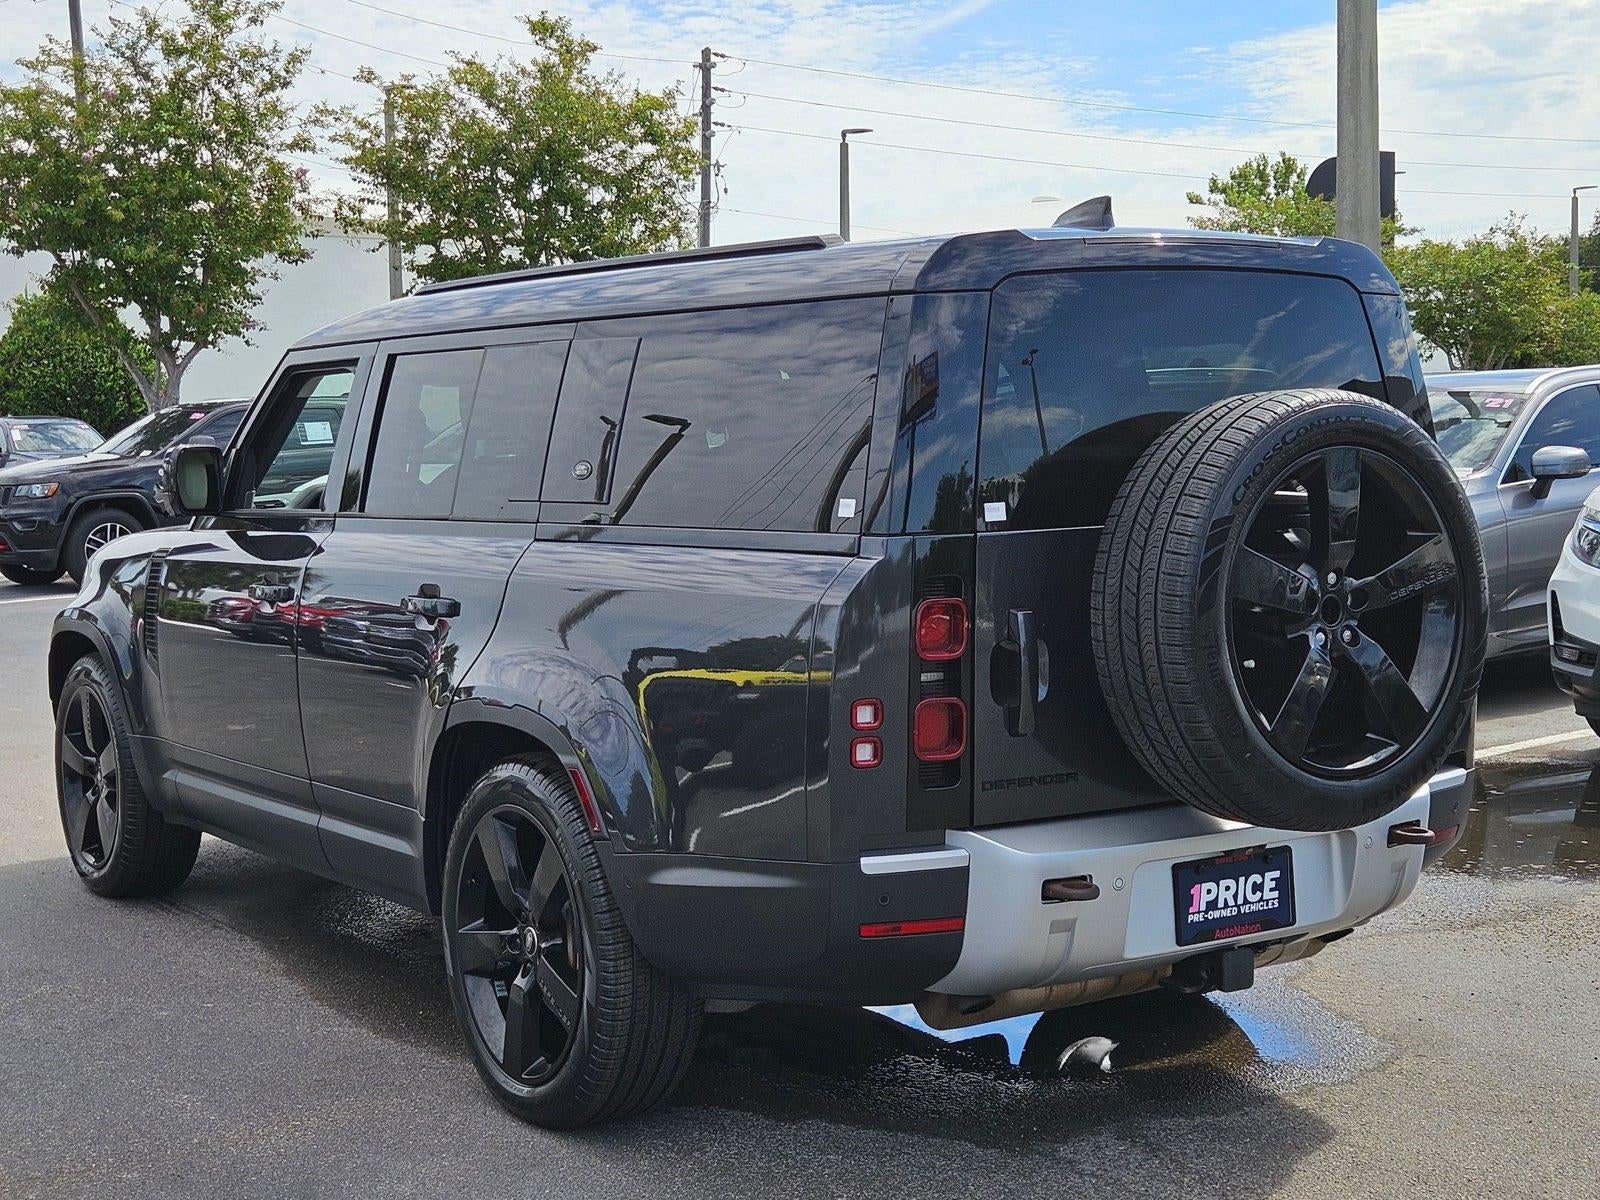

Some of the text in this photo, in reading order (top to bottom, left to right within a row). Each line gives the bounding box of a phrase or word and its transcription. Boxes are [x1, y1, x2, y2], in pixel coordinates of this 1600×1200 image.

[1485, 397, 1514, 409] 21
[1390, 567, 1455, 600] DEFENDER
[981, 771, 1079, 792] DEFENDER
[1188, 870, 1280, 913] 1PRICE
[1187, 898, 1280, 924] PRE-OWNED VEHICLES
[1214, 923, 1262, 940] AutoNation
